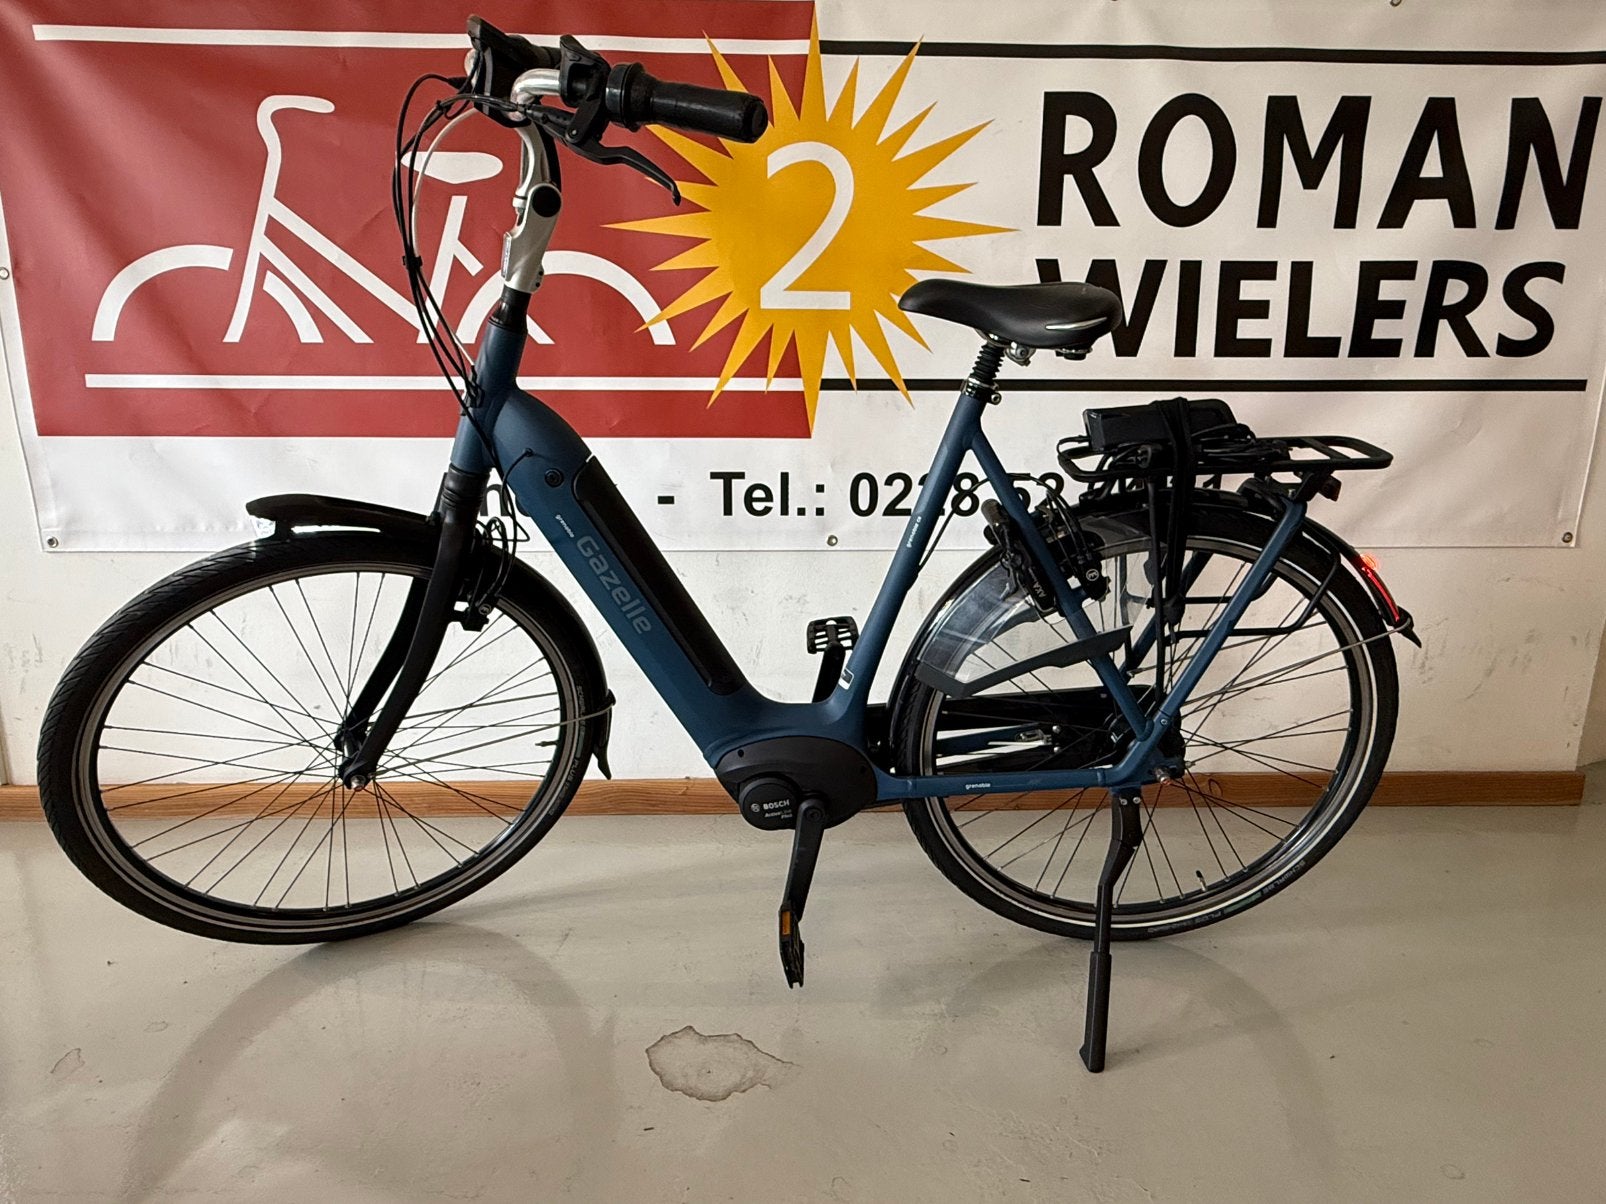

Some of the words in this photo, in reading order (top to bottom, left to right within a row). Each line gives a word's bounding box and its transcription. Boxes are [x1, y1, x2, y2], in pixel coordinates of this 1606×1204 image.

[1036, 91, 1603, 230] ROMAN
[760, 141, 855, 310] 2
[710, 472, 824, 516] Tel.:
[849, 472, 980, 517] 028
[576, 535, 651, 635] Gazelle
[763, 799, 790, 810] BOSCH
